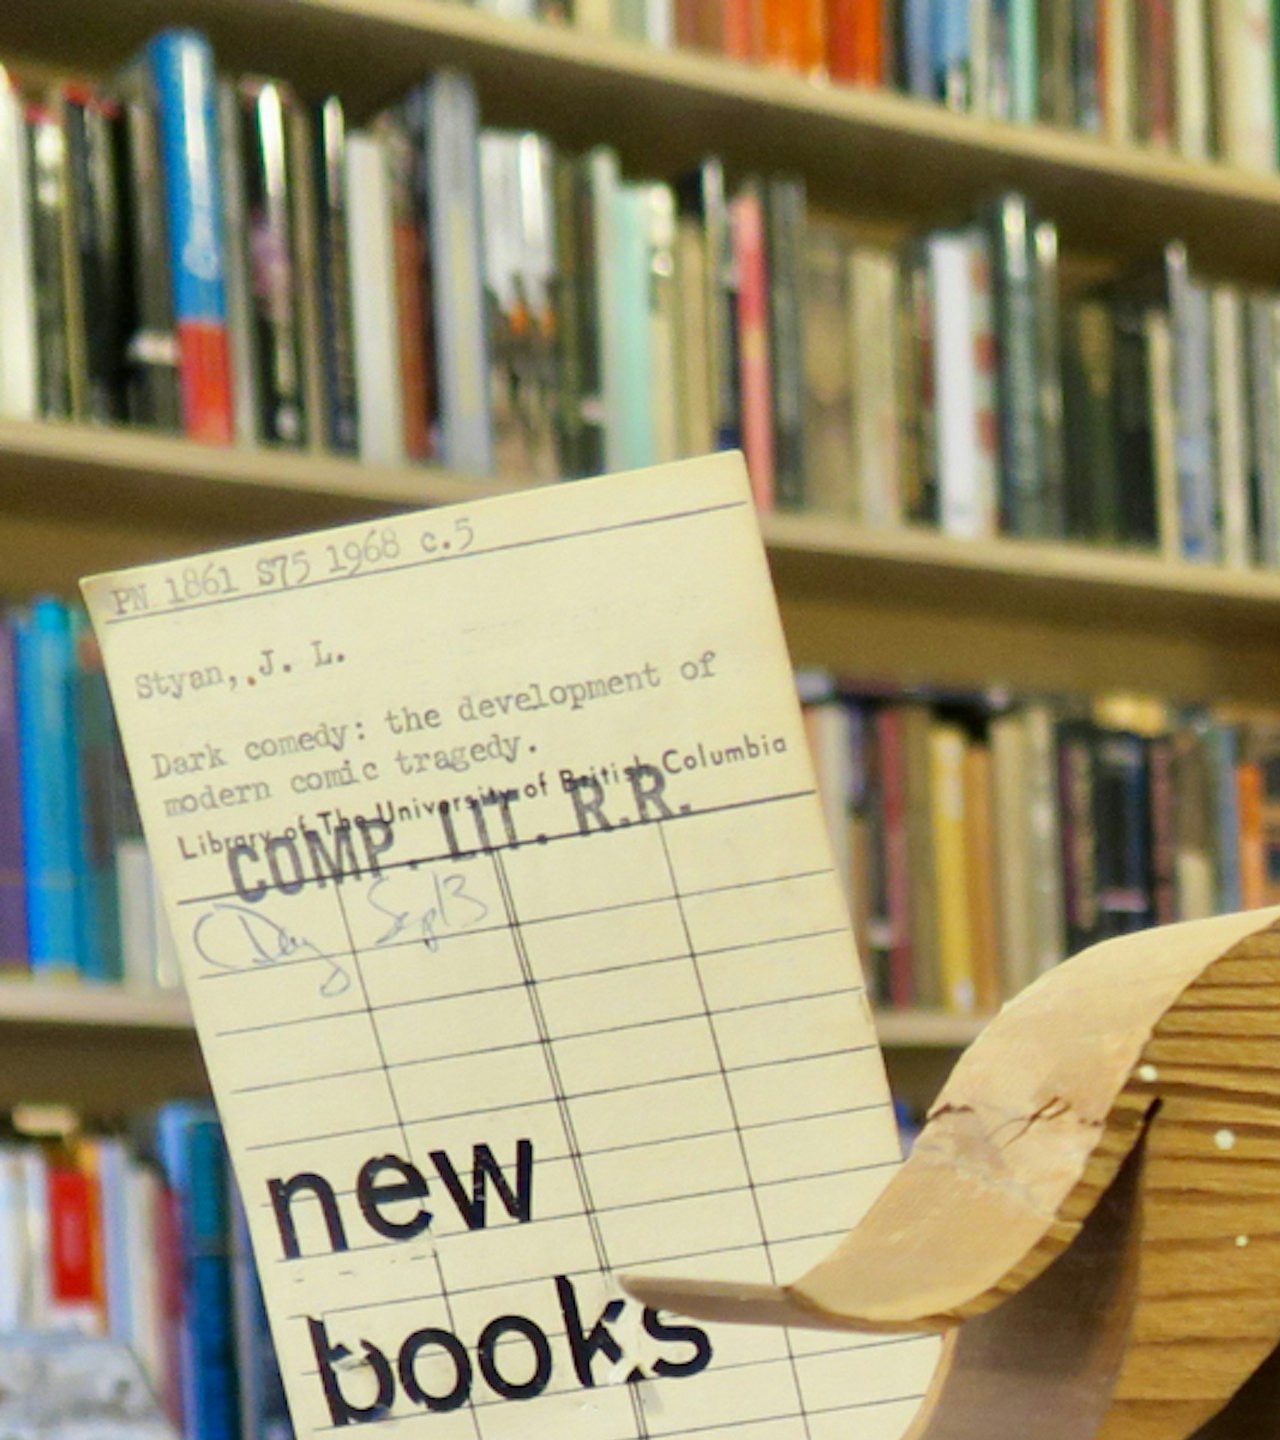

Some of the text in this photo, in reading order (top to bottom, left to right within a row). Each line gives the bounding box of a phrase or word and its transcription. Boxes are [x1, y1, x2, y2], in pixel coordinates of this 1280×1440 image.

[110, 517, 475, 615] PN 1861 S75 1968 c.5
[134, 640, 346, 702] Styan, J. L.
[150, 650, 716, 781] Dark comedy: the development of
[163, 733, 537, 818] modern comic tragedy.
[177, 733, 788, 861] Library of The University of British Columbia
[226, 818, 419, 903] COMP.
[266, 1138, 534, 1261] new
[305, 1274, 714, 1427] books
